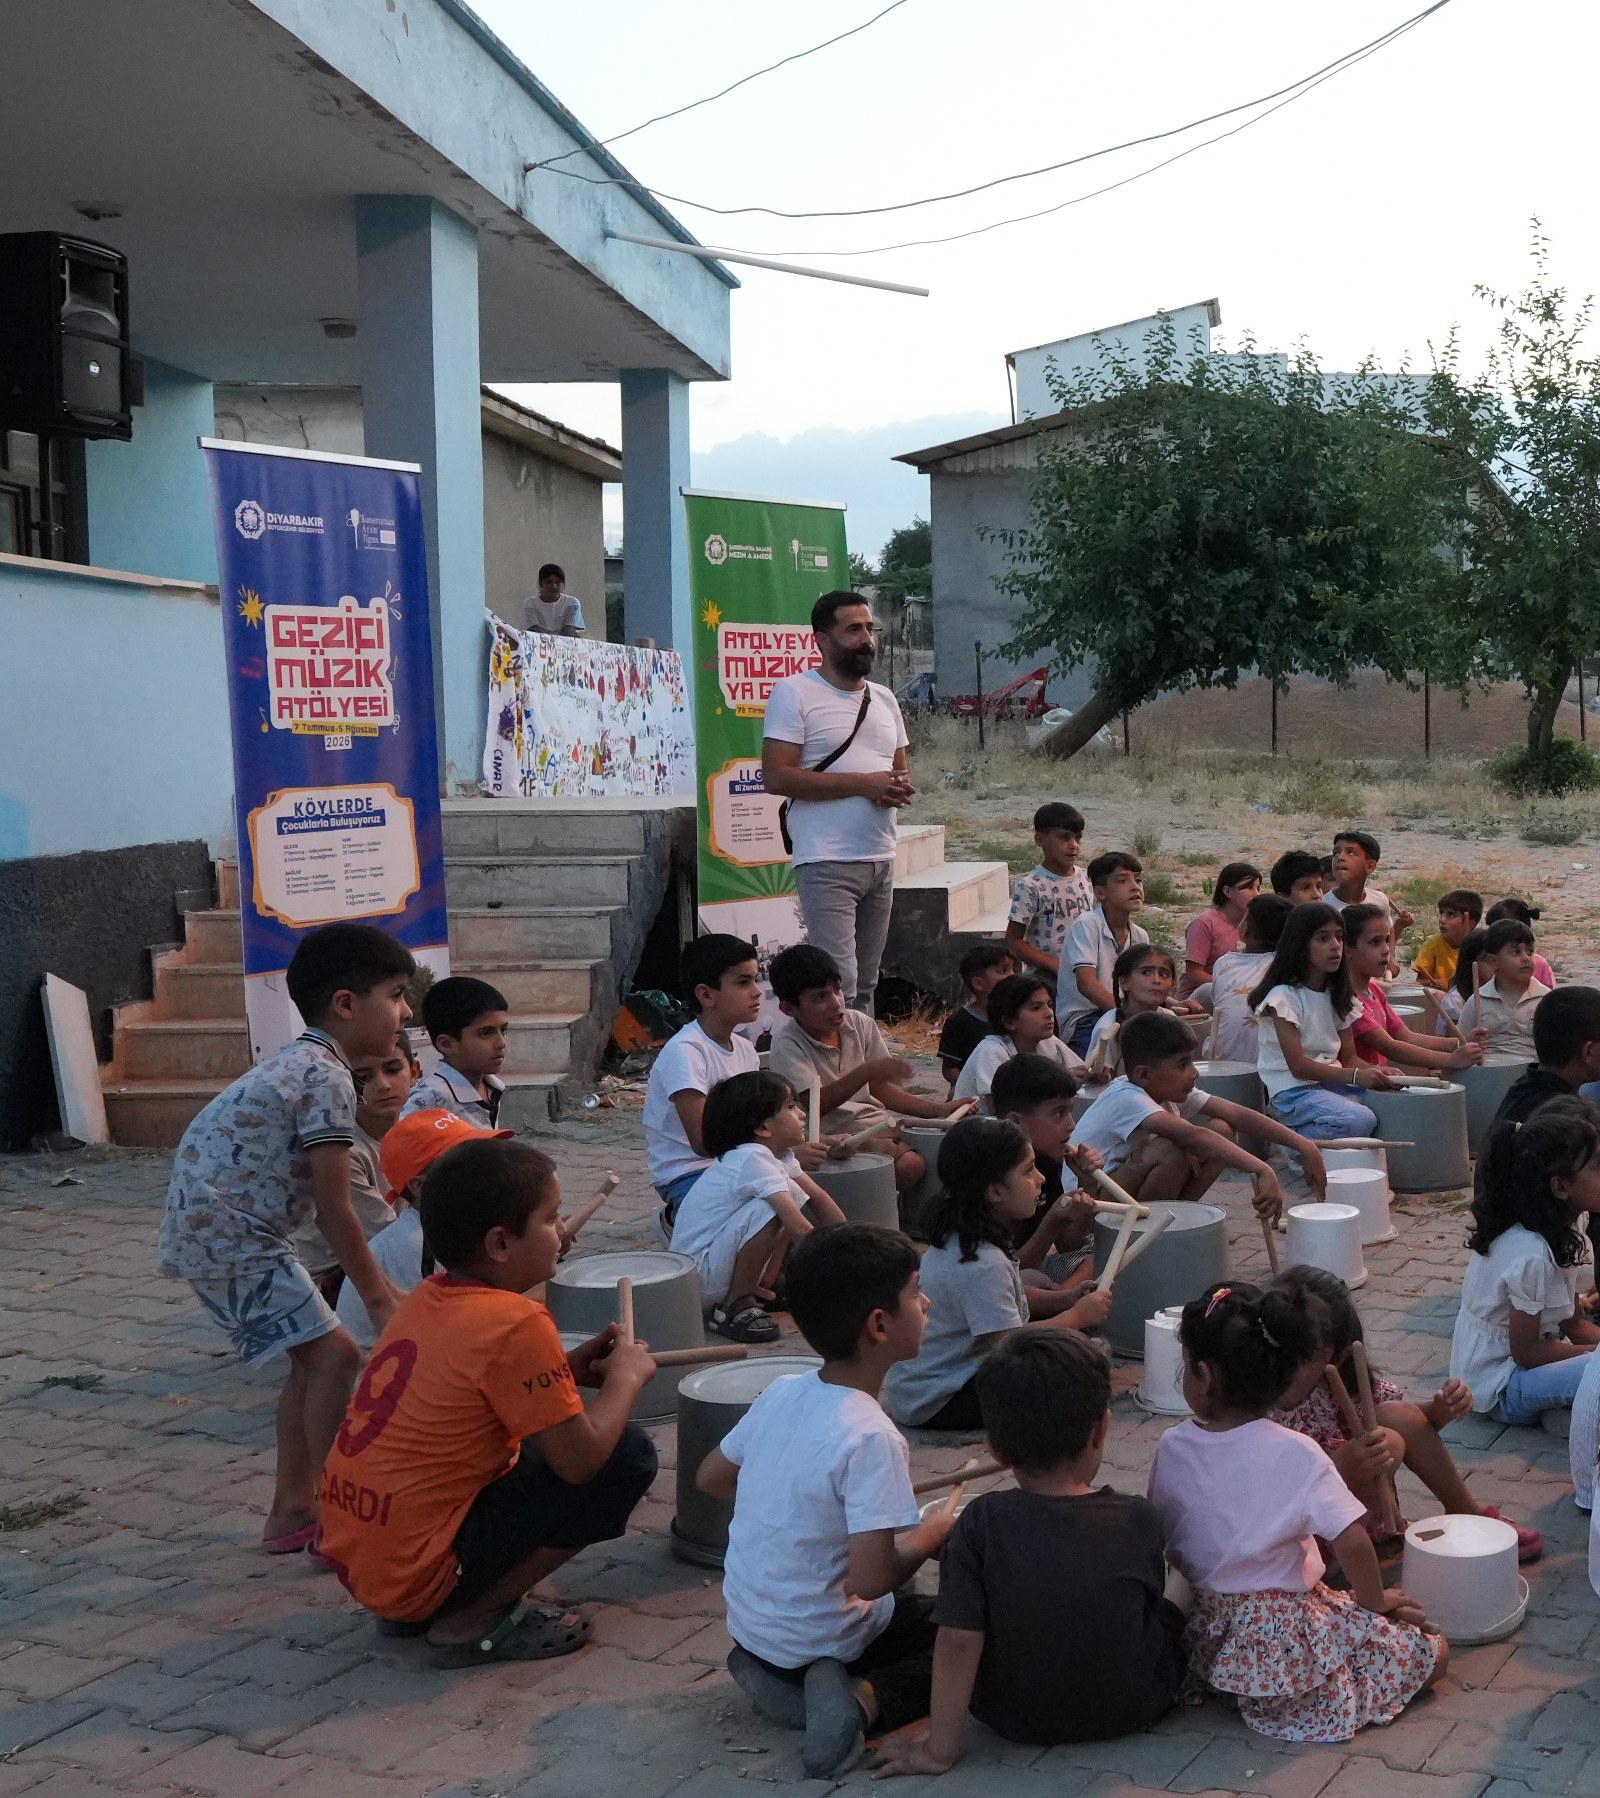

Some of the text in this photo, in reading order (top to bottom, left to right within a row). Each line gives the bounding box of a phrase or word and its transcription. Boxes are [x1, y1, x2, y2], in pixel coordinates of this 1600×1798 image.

[272, 605, 384, 649] GEZİCİ
[275, 649, 384, 688] MÜZİK
[726, 682, 776, 700] YA G
[277, 689, 388, 719] ATÖLYESİ
[345, 725, 377, 734] Ağustos
[326, 736, 350, 748] 2026
[294, 797, 373, 817] KÖYLERDE
[282, 815, 381, 833] Çocuklarla Buluşuyoruz
[337, 1338, 418, 1458] 9
